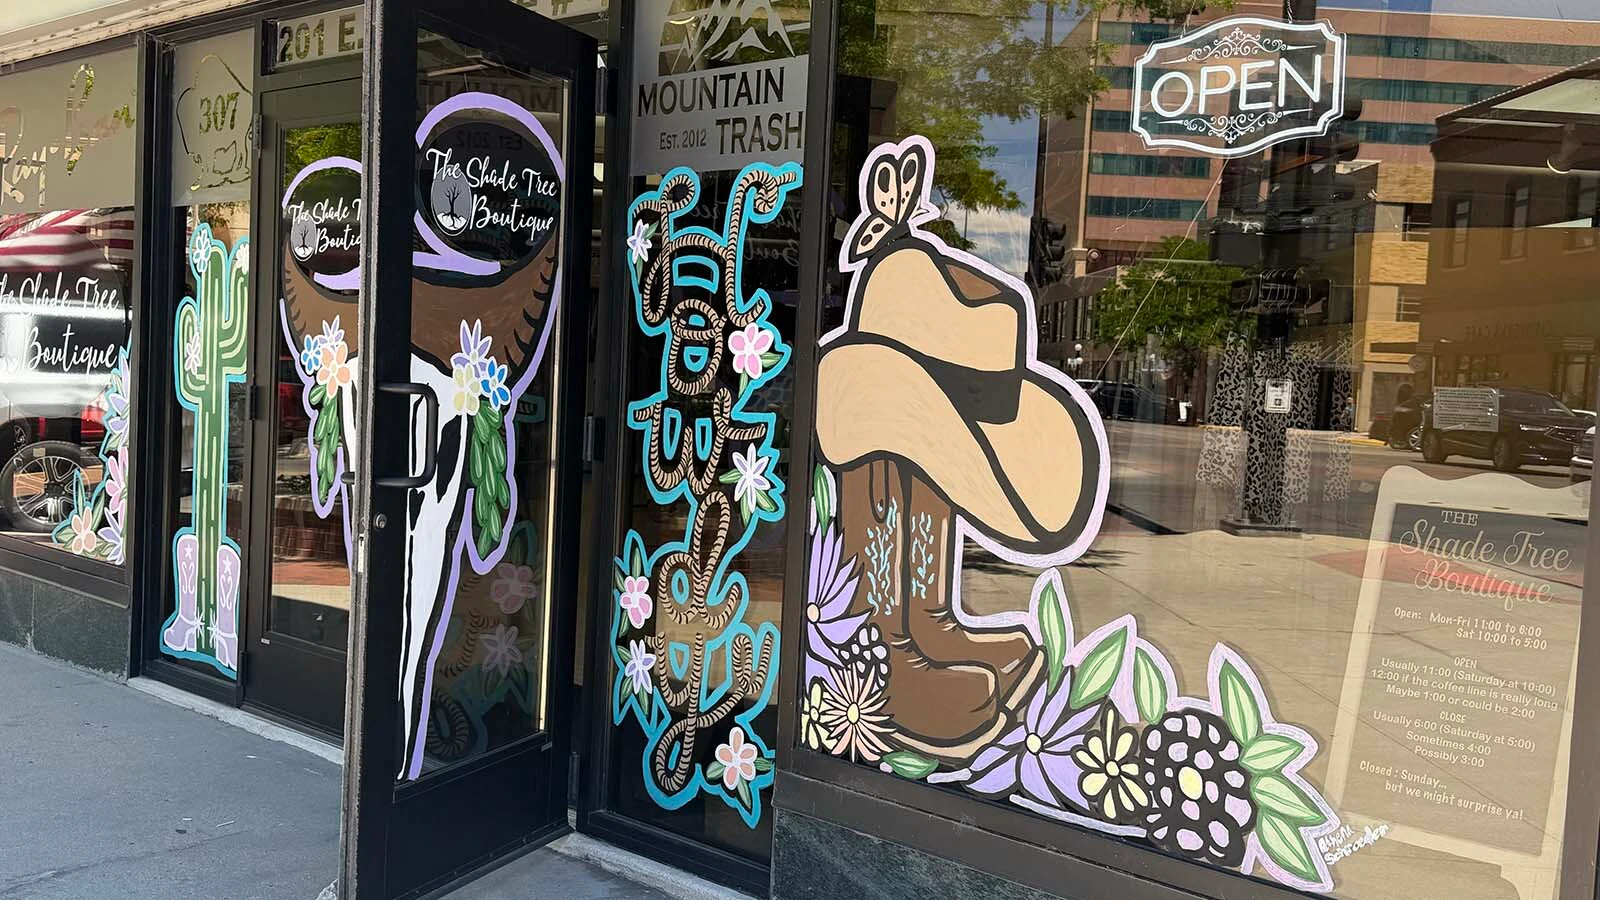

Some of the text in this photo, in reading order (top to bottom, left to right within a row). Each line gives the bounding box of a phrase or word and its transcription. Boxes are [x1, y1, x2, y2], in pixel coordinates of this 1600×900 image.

[280, 19, 325, 63] 201
[638, 66, 785, 118] MOUNTAIN
[1150, 54, 1322, 118] OPEN
[199, 91, 241, 133] 307
[682, 128, 707, 149] 2012
[715, 110, 804, 155] TRASH
[425, 147, 557, 197] The Shade Tree
[288, 200, 312, 227] The
[312, 196, 350, 225] Shade
[19, 270, 72, 316] Shade
[75, 276, 120, 311] Tree
[23, 322, 118, 377] Boutique
[1441, 510, 1479, 527] THE
[1400, 519, 1573, 571] Shade Tree
[1414, 558, 1553, 611] Boutique
[1394, 606, 1543, 638] Open: Mon-Fri 11:00 to 6:00
[1455, 627, 1548, 650] Sat 10:00 to 5:00
[1381, 657, 1557, 697] Usually 11:00 (Saturday at 10:00)
[1454, 656, 1479, 669] OPEN
[1370, 669, 1558, 712] 12:00 if the coffee line is really long
[1385, 684, 1536, 719] Maybe 1:00 or could be 2:00
[1373, 710, 1536, 752] Usually 6:00 (Saturday at 5:00)
[1439, 710, 1468, 724] CLOSE
[1406, 730, 1492, 756] Sometimes 4:00
[1414, 745, 1485, 769] Possibly 3:00
[1359, 759, 1392, 777] Closed
[1385, 780, 1526, 820] but we might surprise ya!
